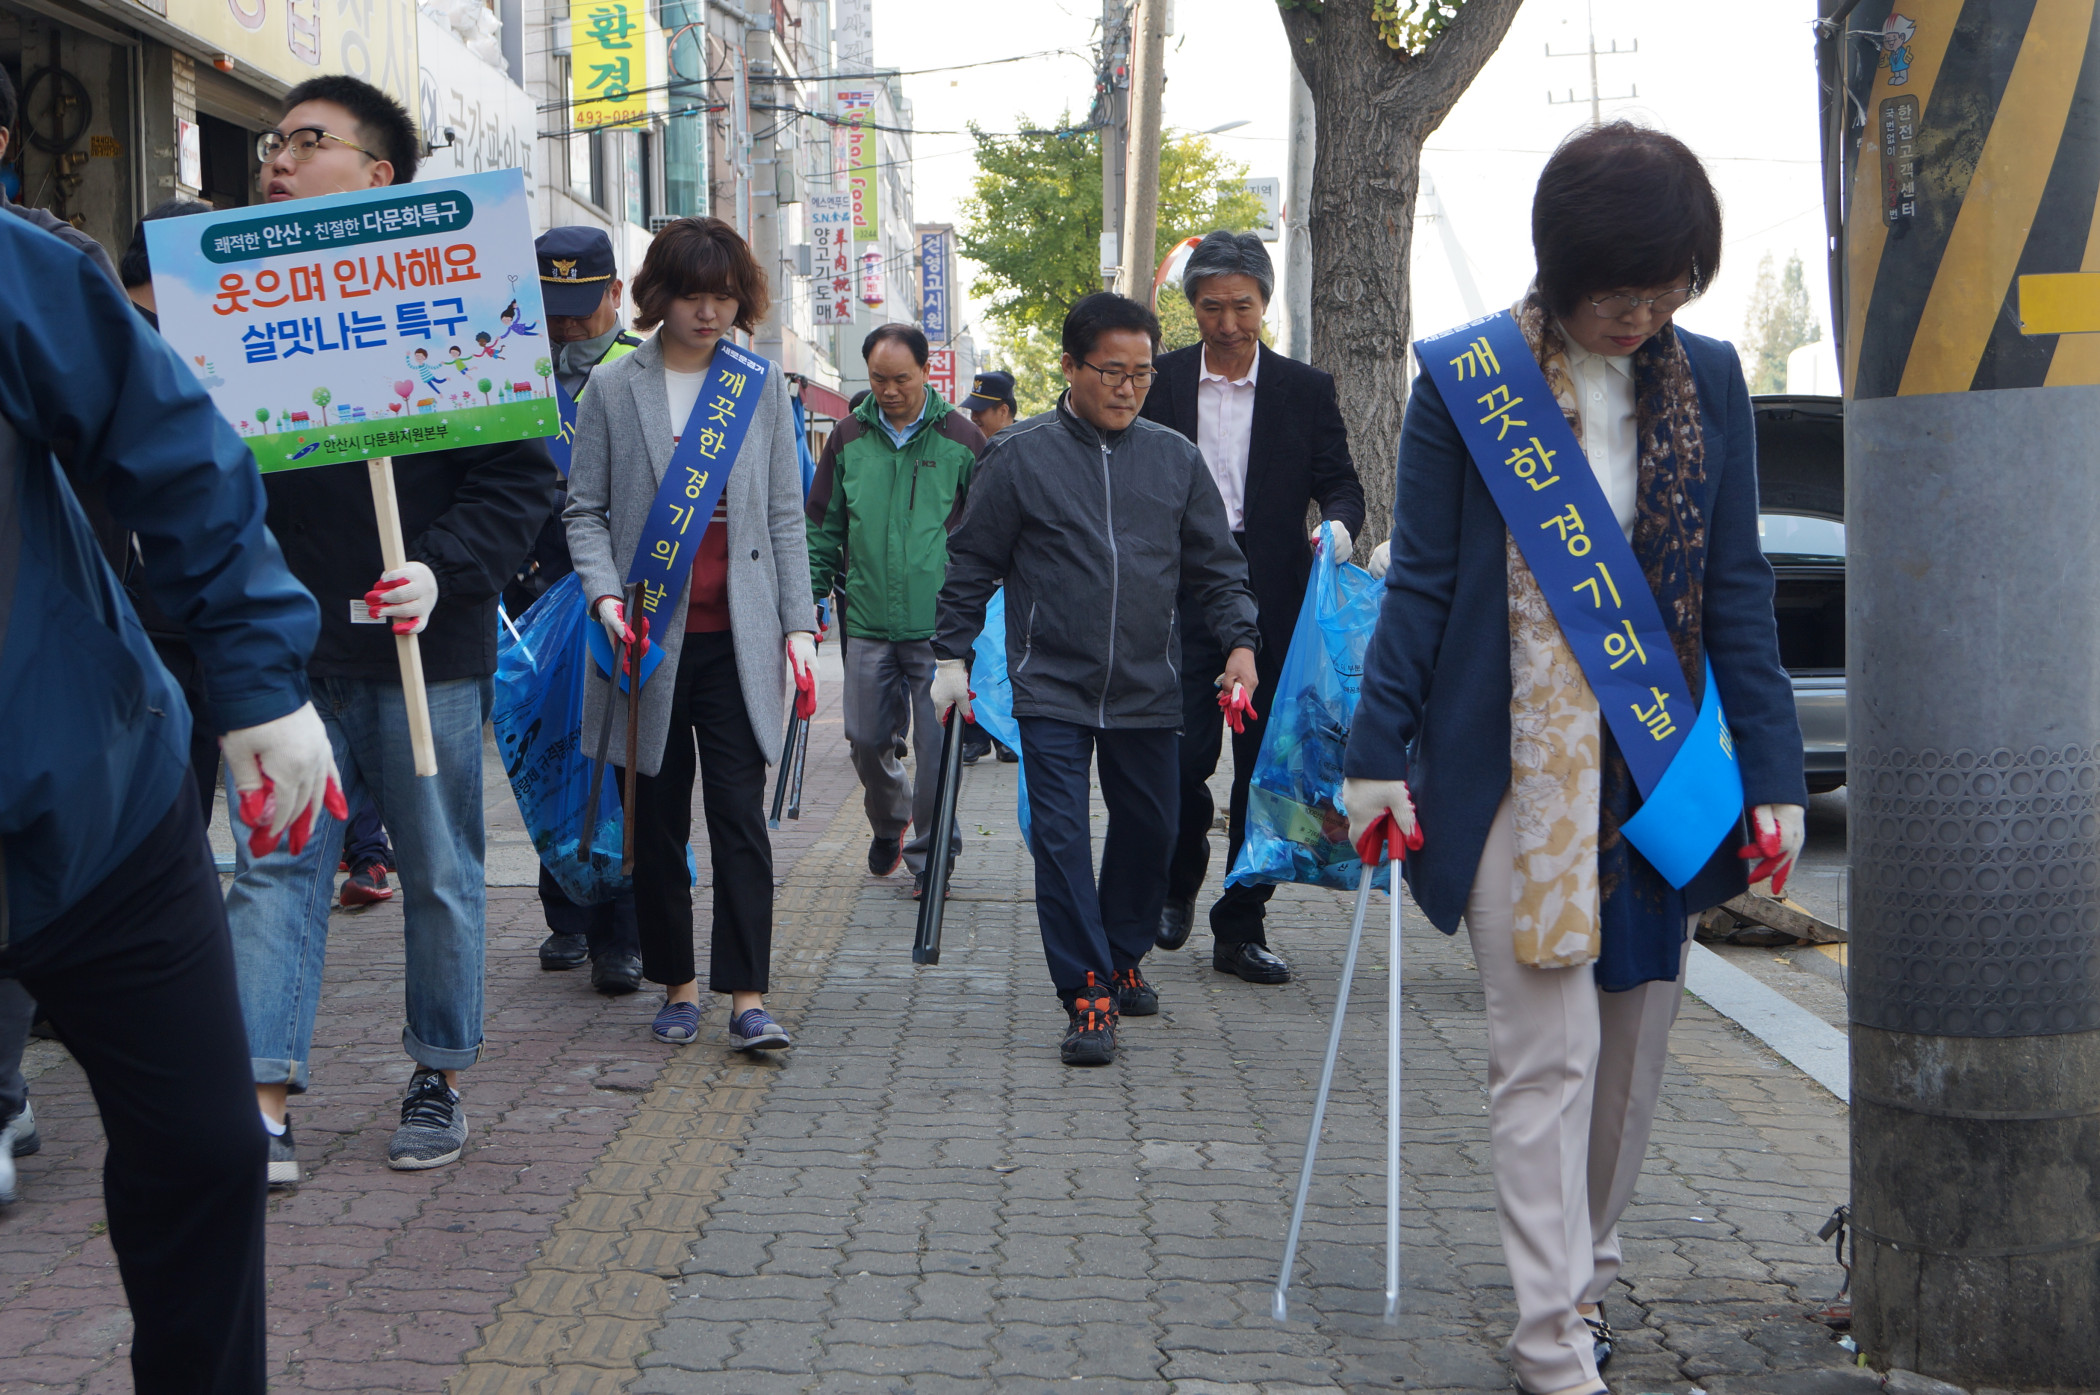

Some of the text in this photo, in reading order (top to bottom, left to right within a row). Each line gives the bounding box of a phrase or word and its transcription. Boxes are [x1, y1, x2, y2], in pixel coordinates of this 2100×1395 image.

[585, 3, 637, 103] 환경
[1885, 107, 1897, 157] 국번없이
[1897, 104, 1916, 217] 한전고객센터
[213, 200, 461, 255] 쾌적한 안산 친절한 다문화특구
[212, 242, 482, 317] 웃으며 인사해요
[240, 296, 469, 365] 살맛나는 특구
[323, 424, 450, 455] 안산시 다문화지원본부
[699, 368, 748, 460] 깨끗한
[921, 459, 937, 468] K2
[650, 465, 710, 571] 경기의
[1449, 336, 1677, 741] 깨끗한 경기의 날
